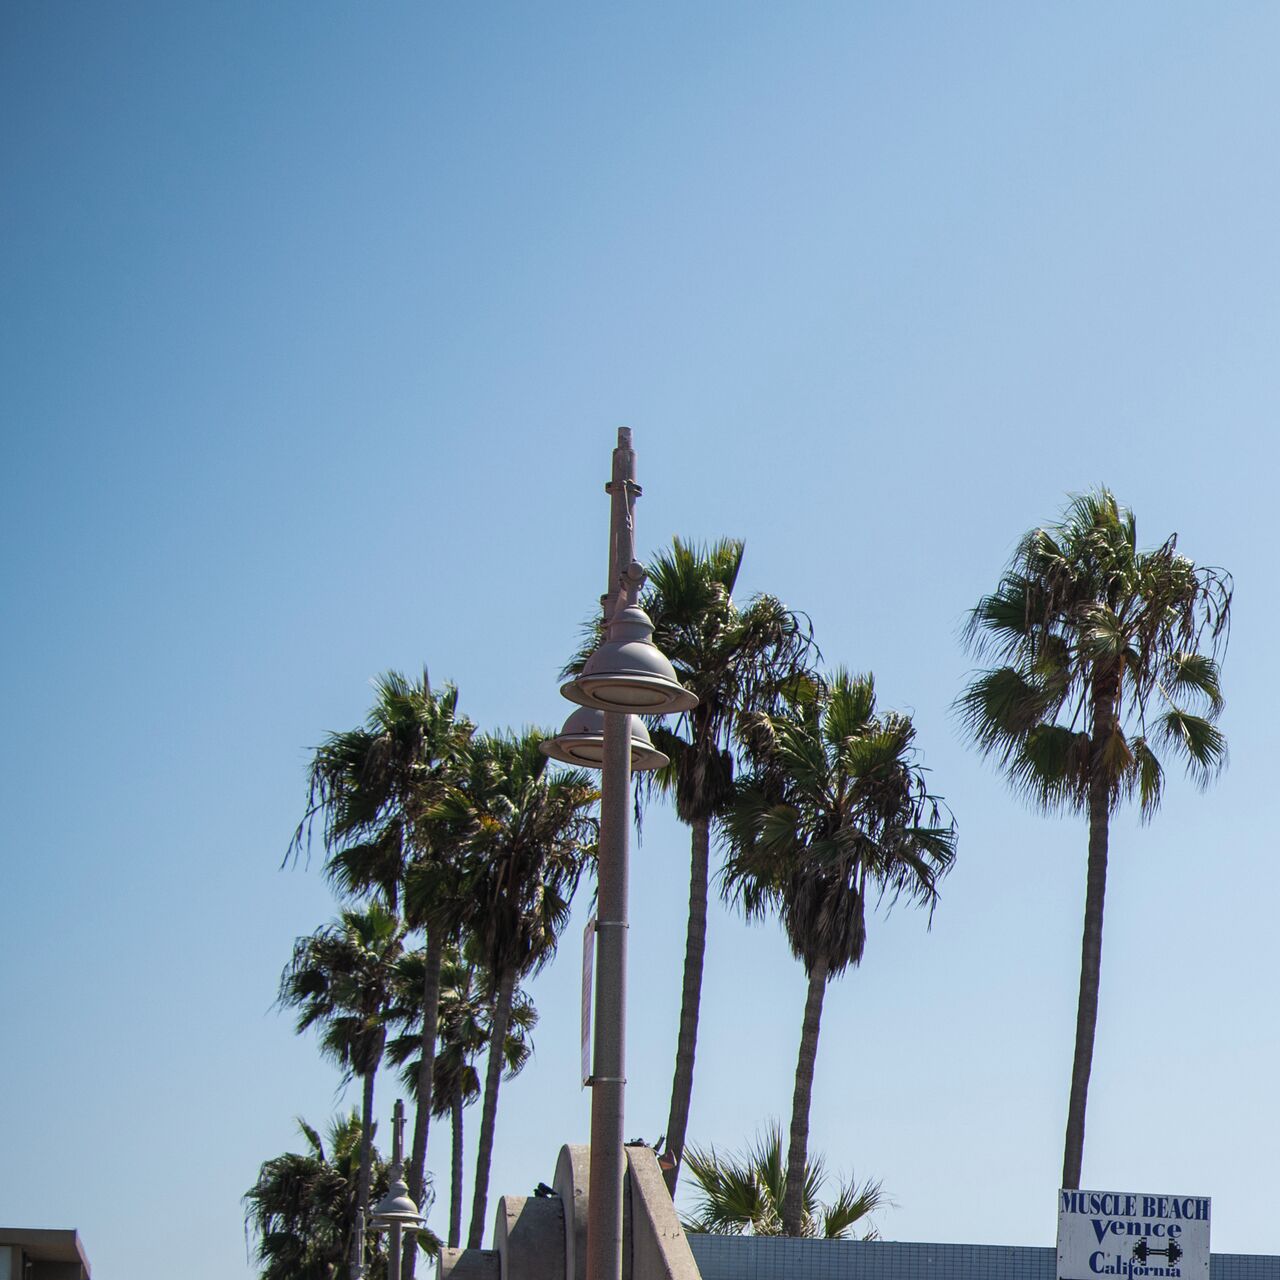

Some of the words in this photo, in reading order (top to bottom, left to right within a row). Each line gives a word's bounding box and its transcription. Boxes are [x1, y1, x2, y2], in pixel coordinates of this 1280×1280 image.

[1061, 1192, 1136, 1216] MUSCLE
[1142, 1197, 1209, 1220] BEACH
[1090, 1219, 1182, 1245] Venice
[1089, 1251, 1181, 1280] California
